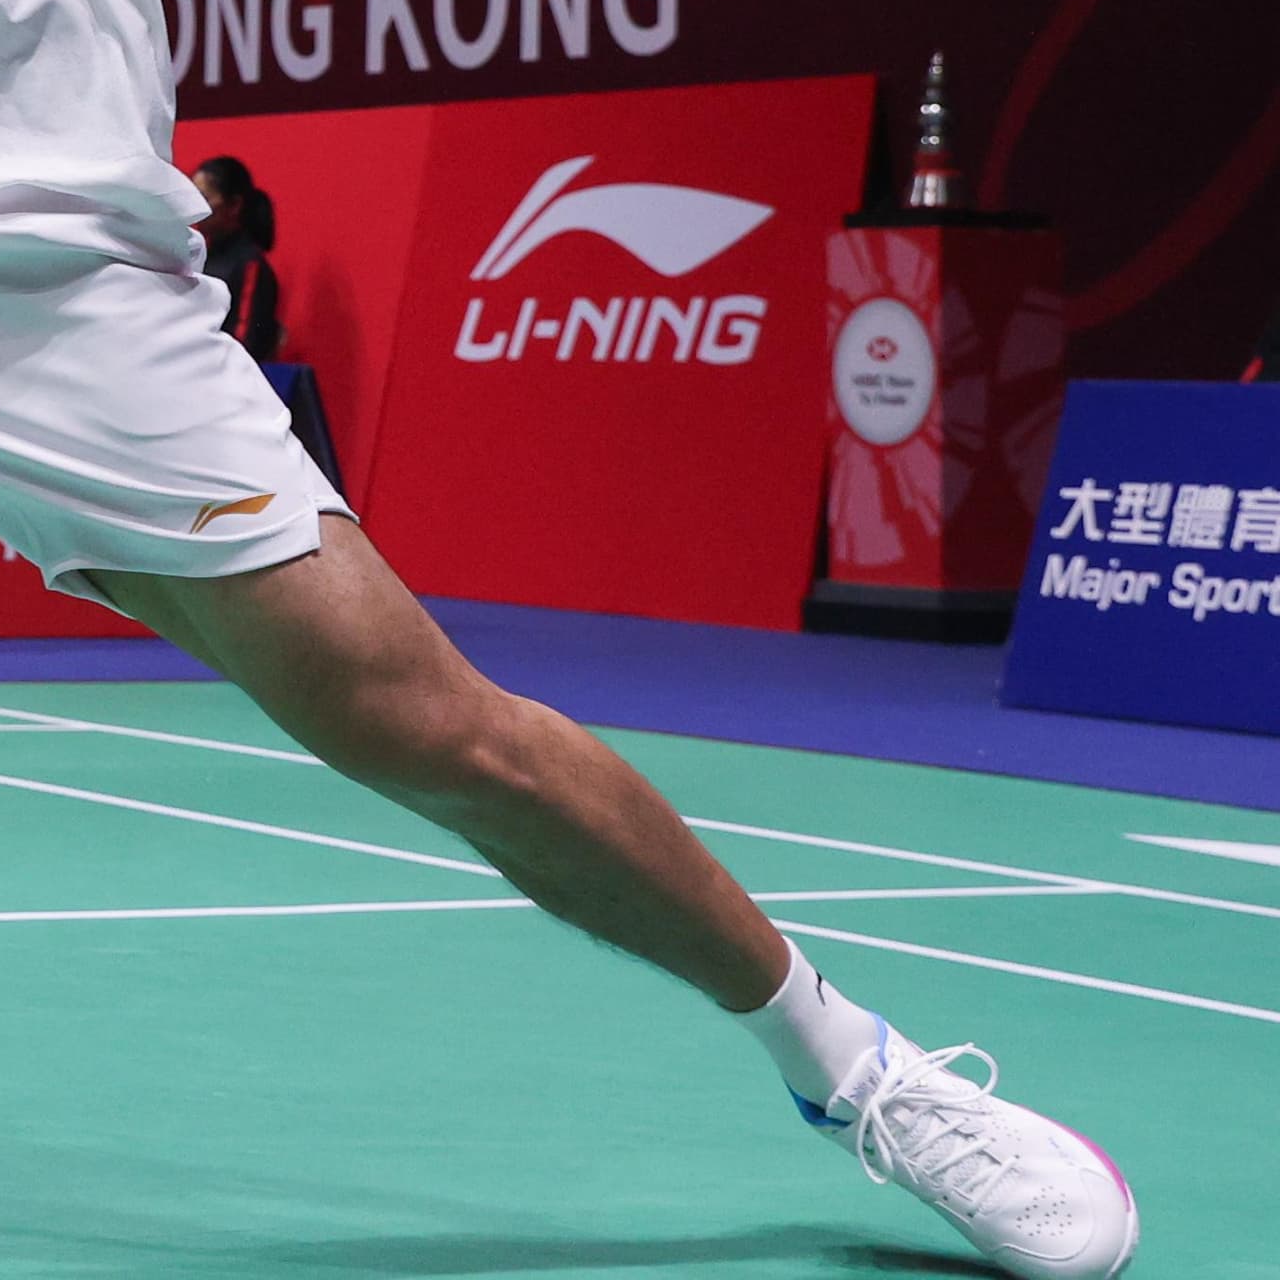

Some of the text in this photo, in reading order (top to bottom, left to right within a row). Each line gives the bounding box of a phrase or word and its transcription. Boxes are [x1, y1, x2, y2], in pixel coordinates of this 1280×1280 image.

[453, 294, 768, 365] LI-NING
[1049, 477, 1280, 554] 大型體育
[1040, 553, 1161, 612] Major
